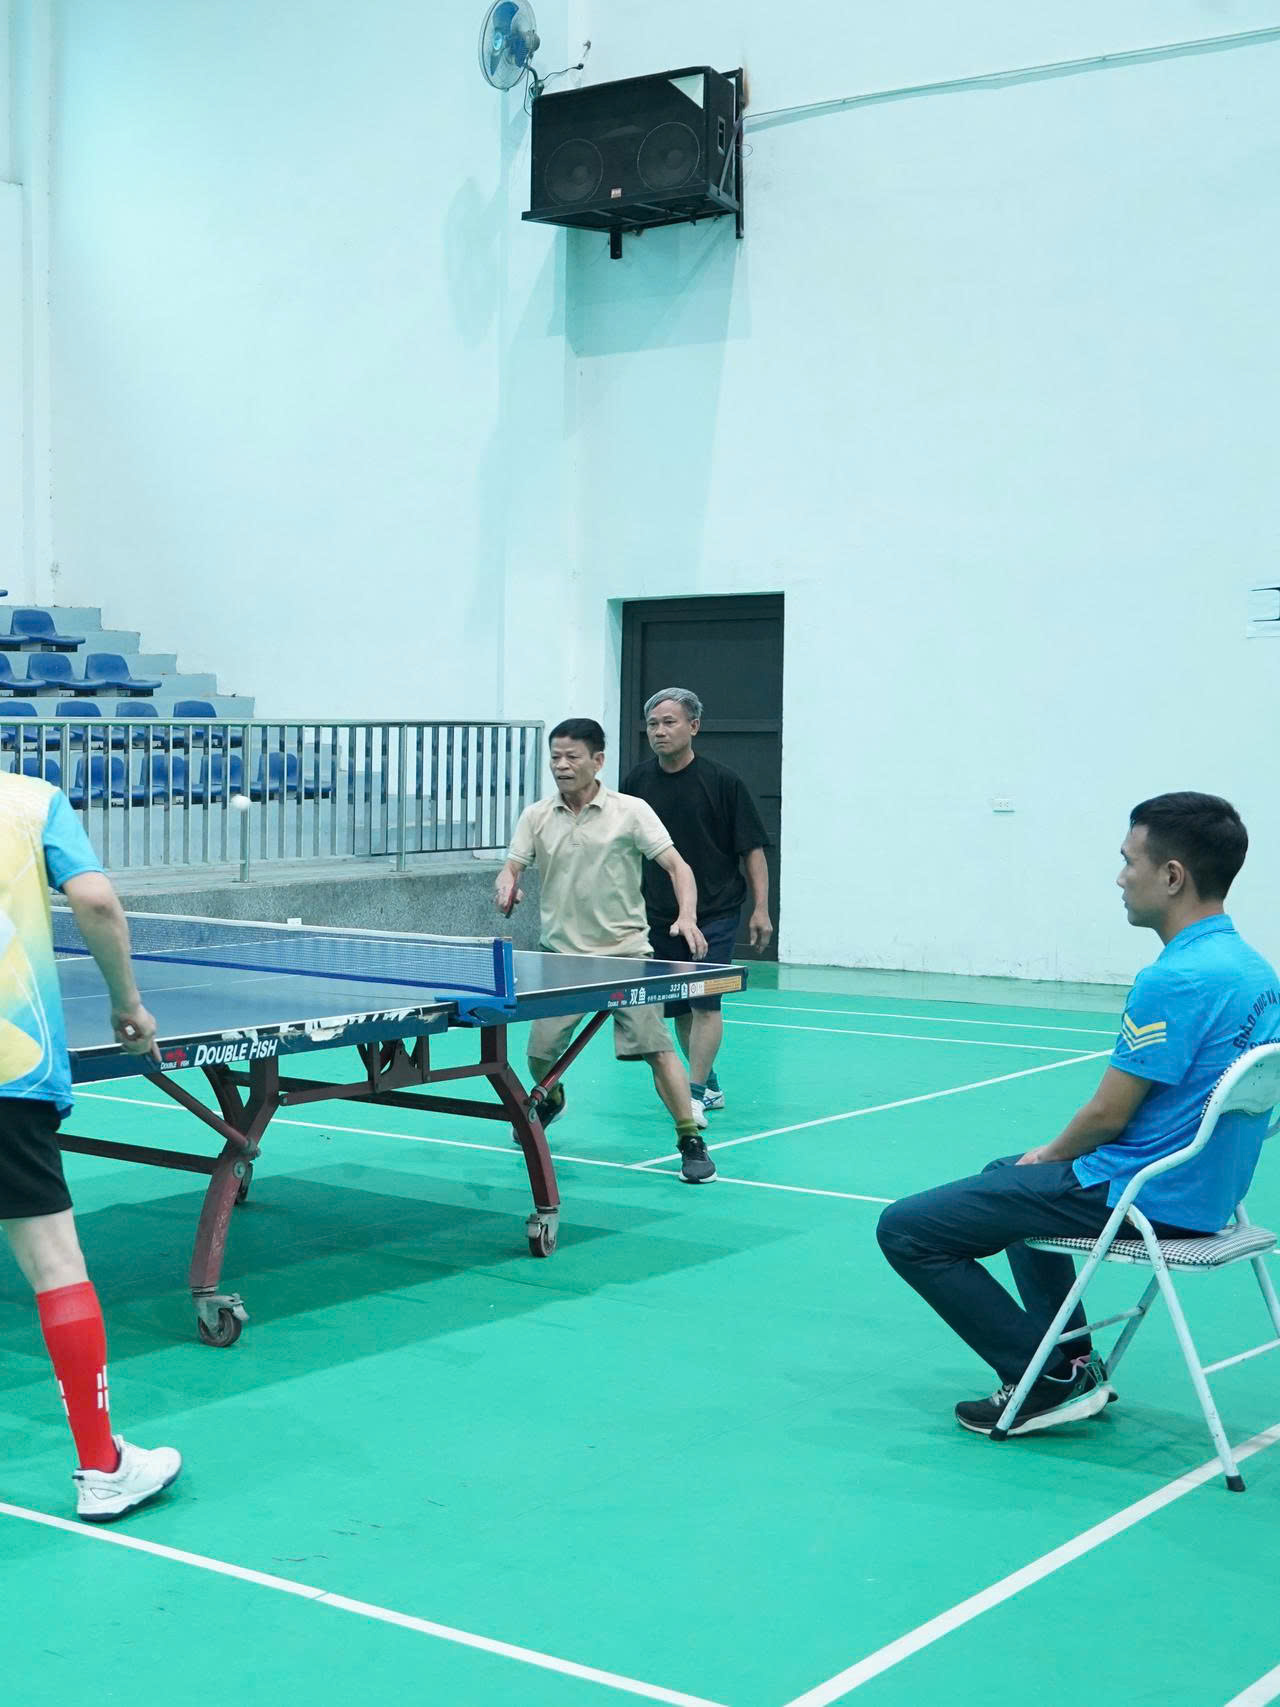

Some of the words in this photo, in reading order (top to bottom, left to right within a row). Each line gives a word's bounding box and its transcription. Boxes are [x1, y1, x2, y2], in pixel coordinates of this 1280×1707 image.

[629, 987, 646, 1005] 双鱼
[194, 1043, 248, 1066] DOUBLE
[249, 1039, 278, 1060] FISH
